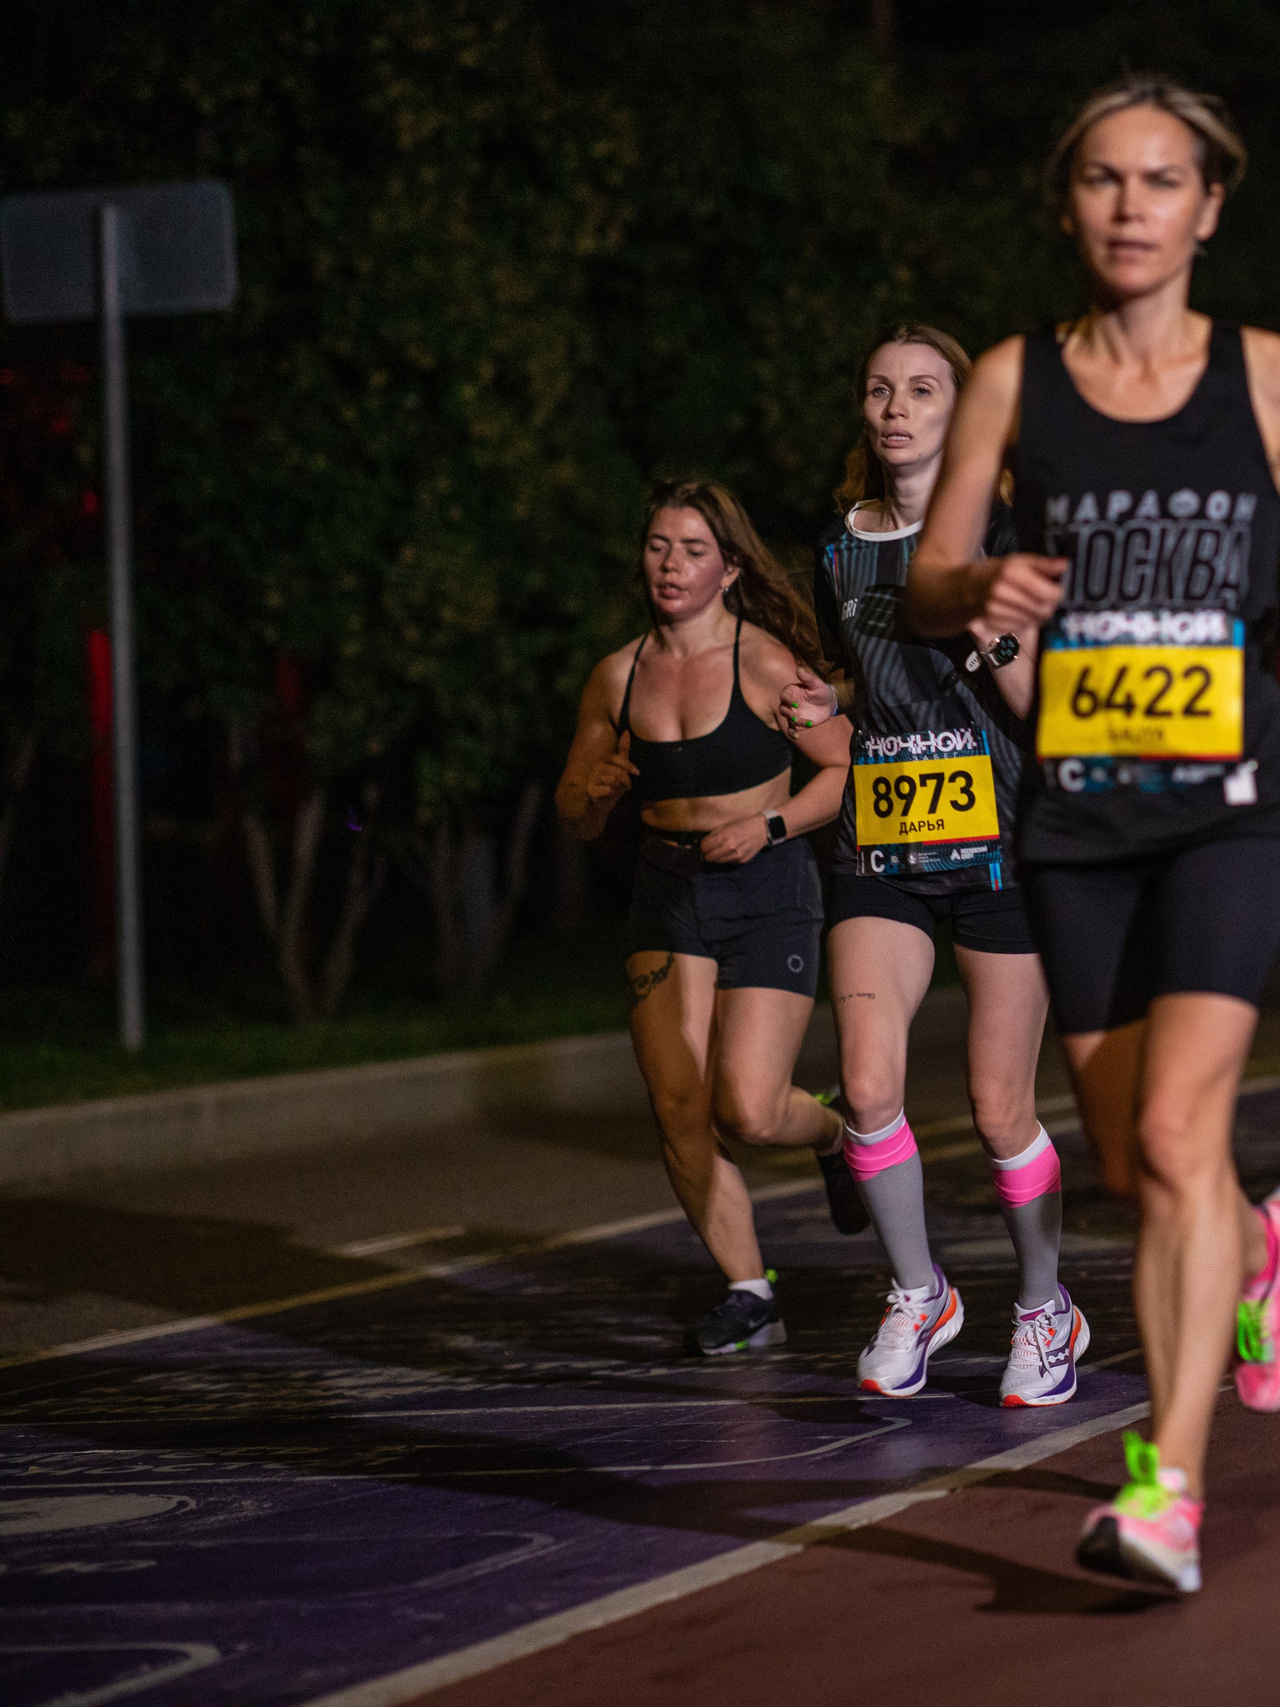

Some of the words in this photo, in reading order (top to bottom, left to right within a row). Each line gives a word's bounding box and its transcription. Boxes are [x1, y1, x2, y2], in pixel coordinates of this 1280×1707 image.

[1045, 487, 1258, 522] МАРАФОН
[1071, 664, 1214, 720] 6422
[872, 770, 976, 818] 8973
[899, 819, 945, 836] ДАРЬЯ
